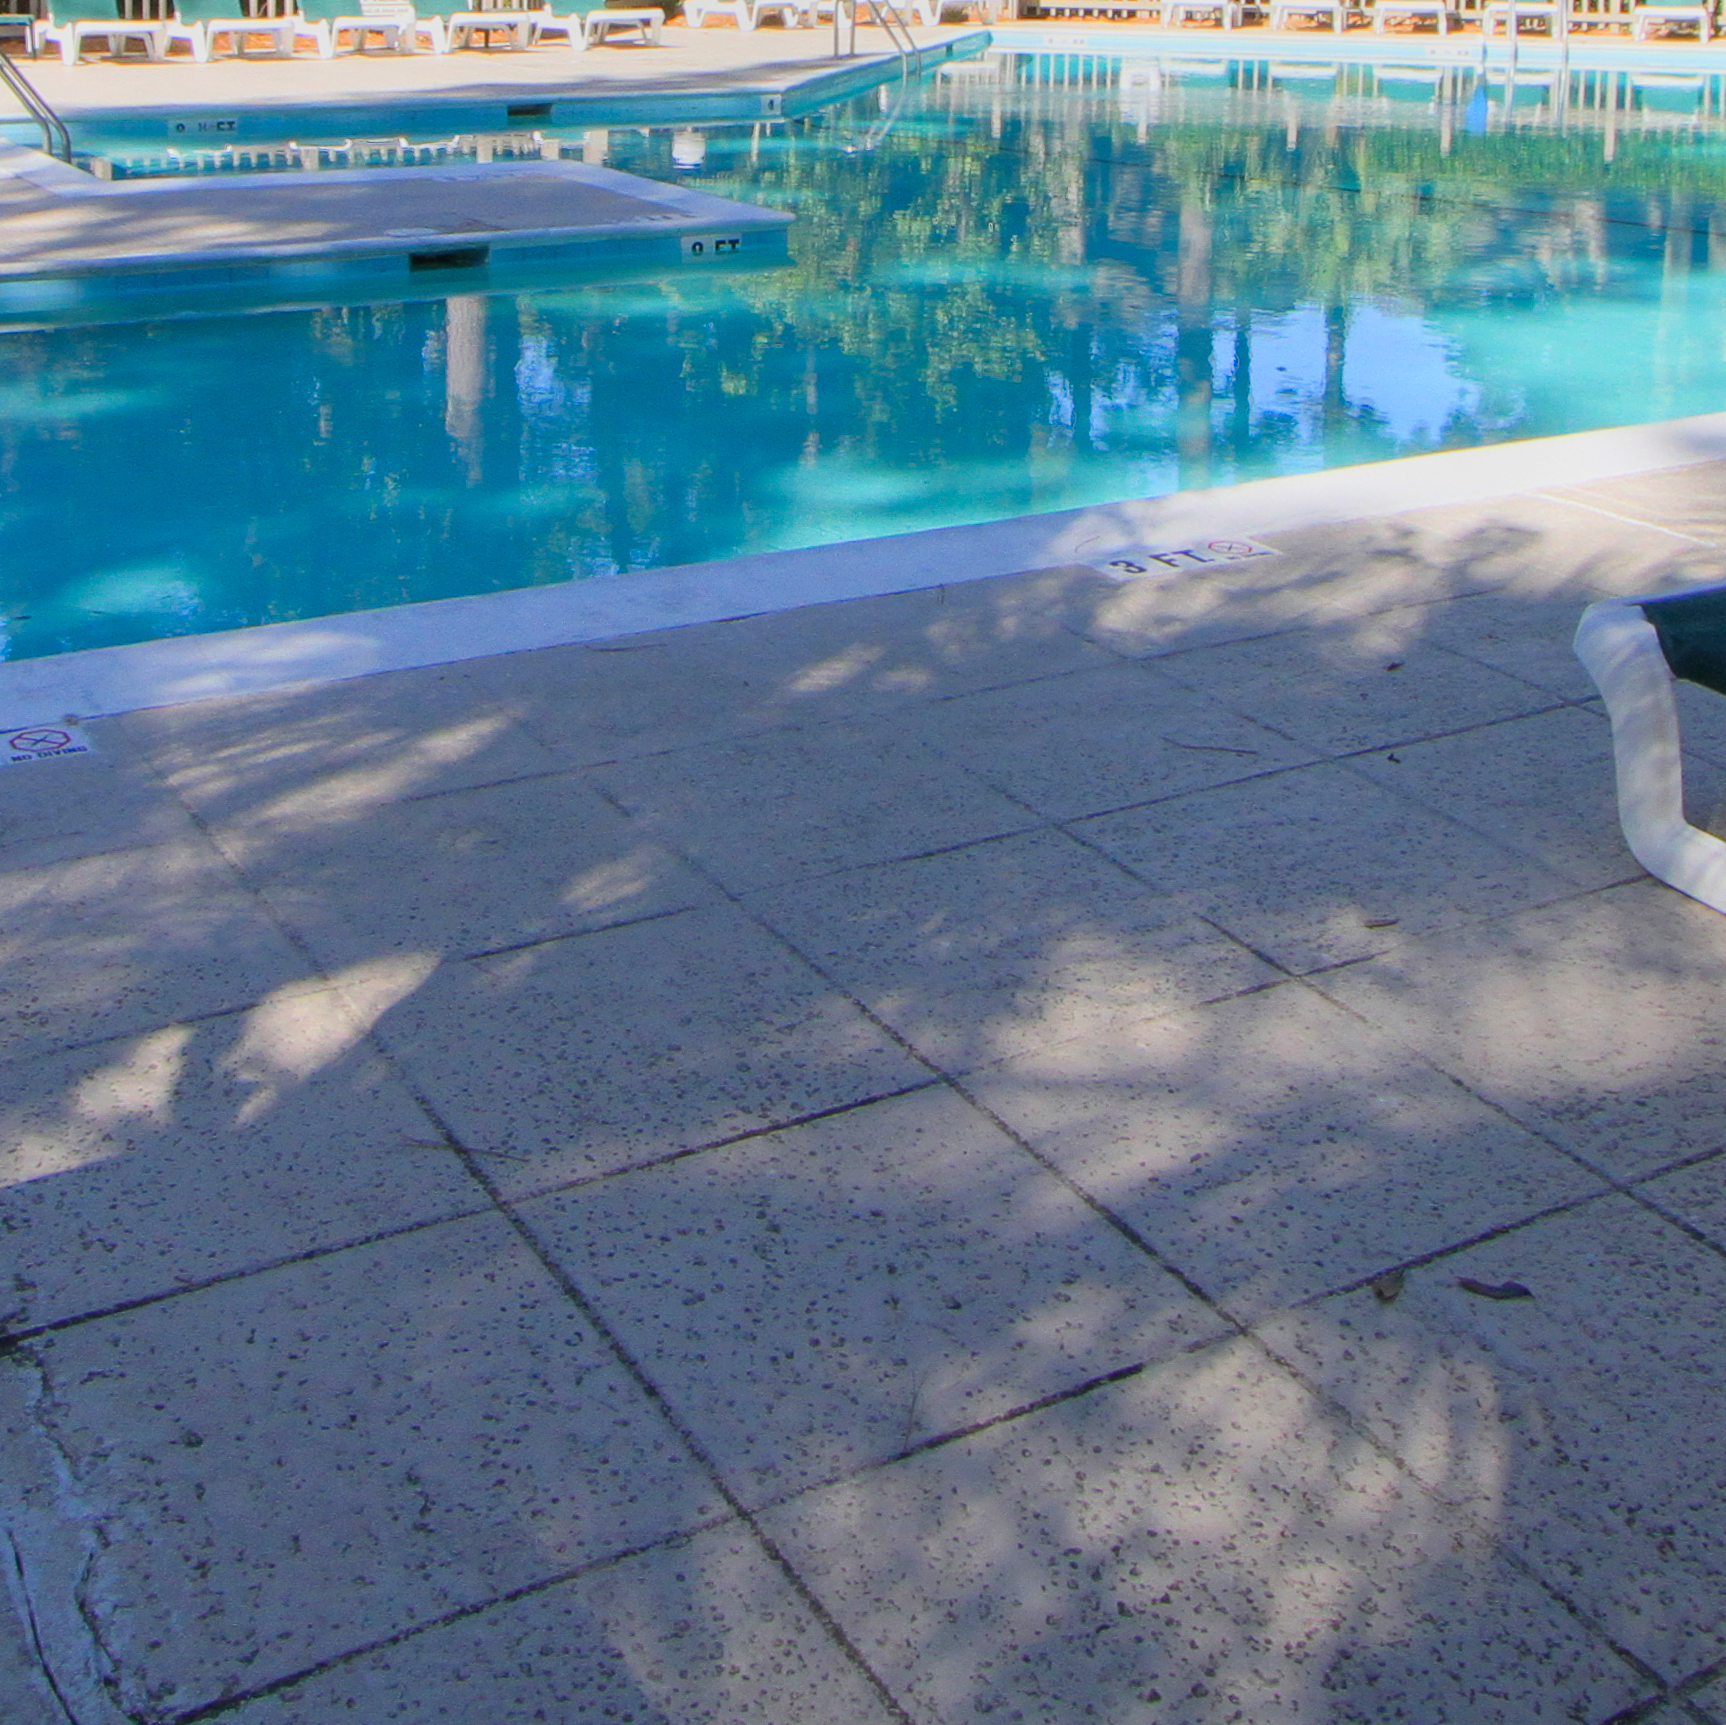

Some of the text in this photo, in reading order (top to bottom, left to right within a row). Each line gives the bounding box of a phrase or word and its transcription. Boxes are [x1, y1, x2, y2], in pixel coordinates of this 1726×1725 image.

[1108, 559, 1148, 575] 3
[10, 744, 88, 763] NO DIVING
